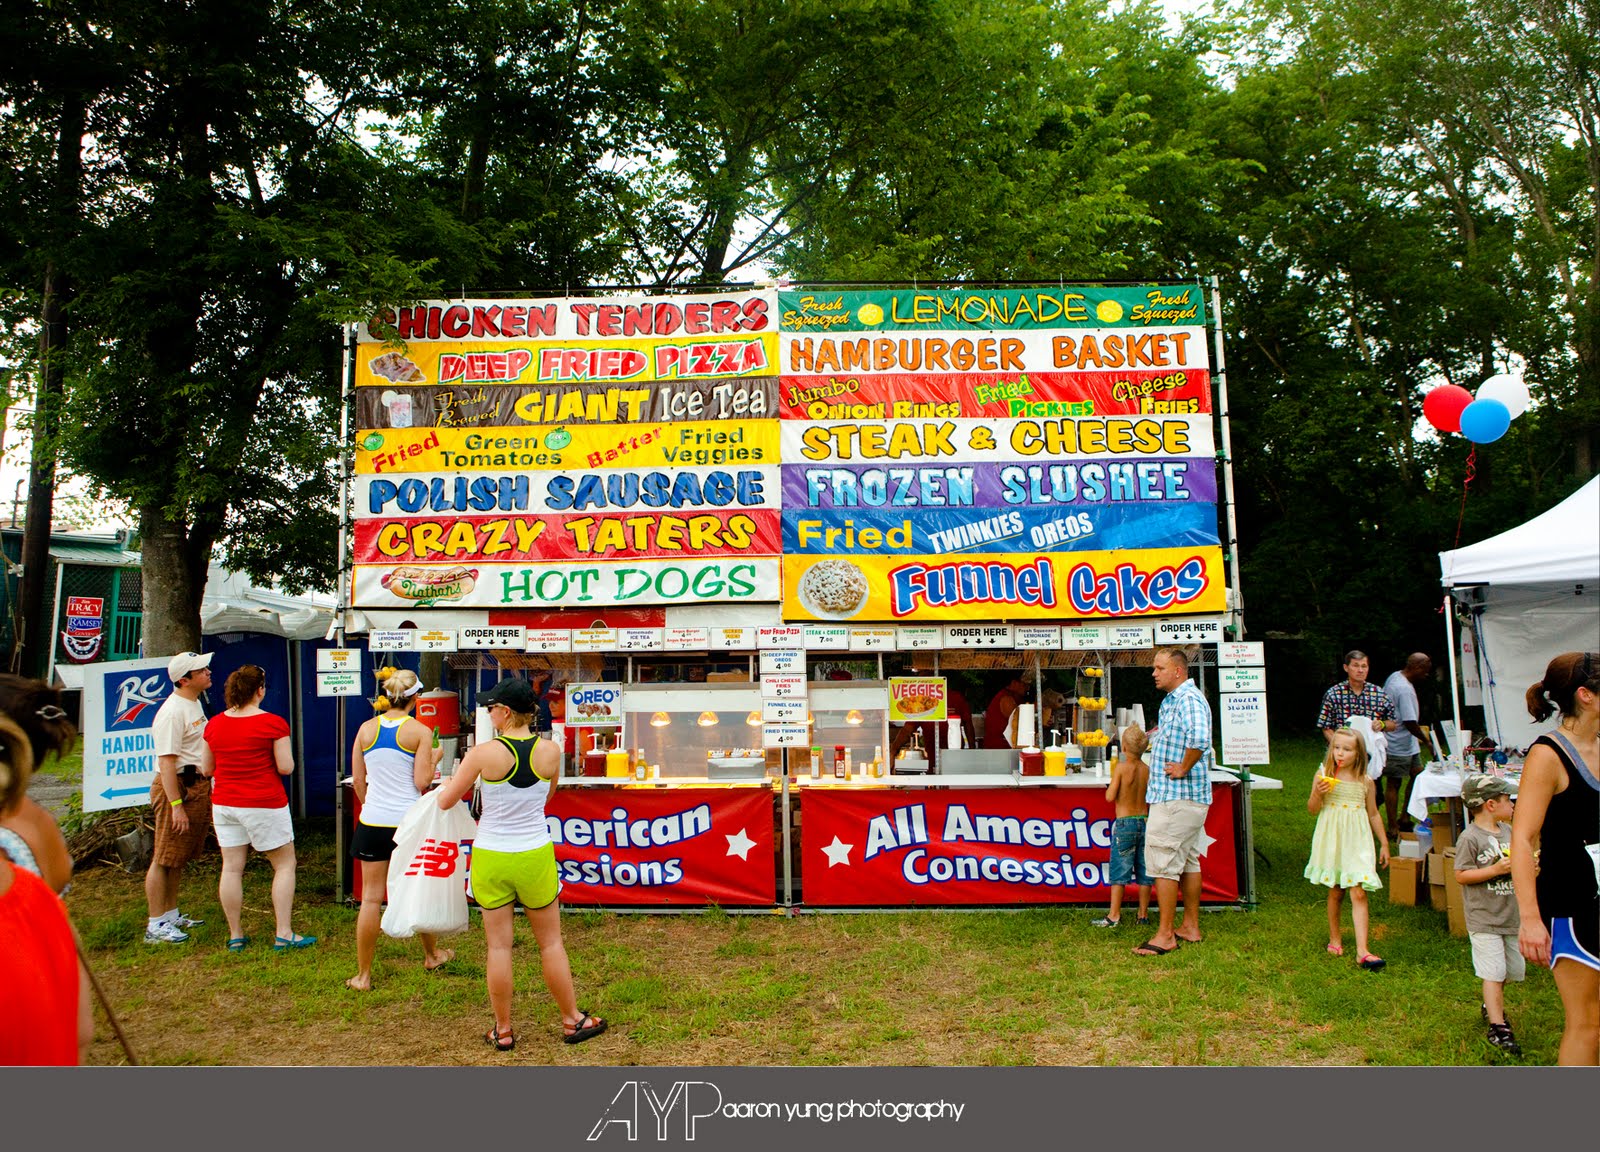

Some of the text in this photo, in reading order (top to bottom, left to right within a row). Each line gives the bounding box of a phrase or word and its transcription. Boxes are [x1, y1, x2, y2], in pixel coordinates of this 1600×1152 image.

[800, 296, 843, 311] Fresh
[891, 294, 1089, 325] LEMONADE
[1146, 290, 1190, 308] Fresh
[367, 297, 769, 340] CHICKEN TENDERS
[782, 310, 850, 330] Squeezed
[1130, 305, 1197, 324] Squeezed
[437, 337, 770, 384] DEEP FRIED PIZZA
[790, 332, 1191, 373] HAMBURGER BASKET
[434, 387, 487, 409] Fresh
[788, 376, 860, 407] Jumbo
[974, 375, 1035, 405] Fried
[1111, 372, 1187, 402] Cheese
[434, 401, 500, 428] Brewed
[514, 384, 767, 423] GIANT Ice Tea
[807, 401, 886, 419] ONION
[1009, 400, 1095, 417] PICKLES
[1140, 397, 1200, 415] FRIES
[465, 433, 538, 451] Green
[586, 426, 663, 469] Batter
[680, 427, 744, 446] Fried
[801, 416, 1192, 460] STEAK & CHEESE
[371, 430, 440, 473] Fried
[440, 450, 562, 467] Tomatoes
[662, 444, 764, 465] Veggies
[368, 470, 766, 514] POLISH SAUSAGE
[805, 462, 1190, 507] FROZEN SLUSHEE
[377, 514, 757, 558] CRAZY TATERS
[798, 519, 914, 549] Fried
[928, 511, 1024, 554] TWINKIES
[1031, 512, 1094, 548] OREOS
[402, 580, 462, 598] Nathan's
[500, 564, 756, 603] HOT DOGS
[890, 556, 1210, 617] Funnel Cakes
[70, 603, 101, 612] TRACY
[69, 617, 101, 627] RAMSEY
[465, 629, 520, 637] ORDER HERE
[786, 627, 801, 635] PIZZA
[950, 628, 1008, 637] ORDER HERE
[1161, 623, 1217, 632] ORDER HERE
[114, 674, 166, 716] RC
[572, 689, 620, 705] OREO'S
[891, 684, 944, 700] VEGGIES
[102, 734, 155, 755] HANDI
[106, 754, 156, 776] PARKI
[864, 803, 1117, 862] All Americ
[901, 849, 1110, 887] Concessio
